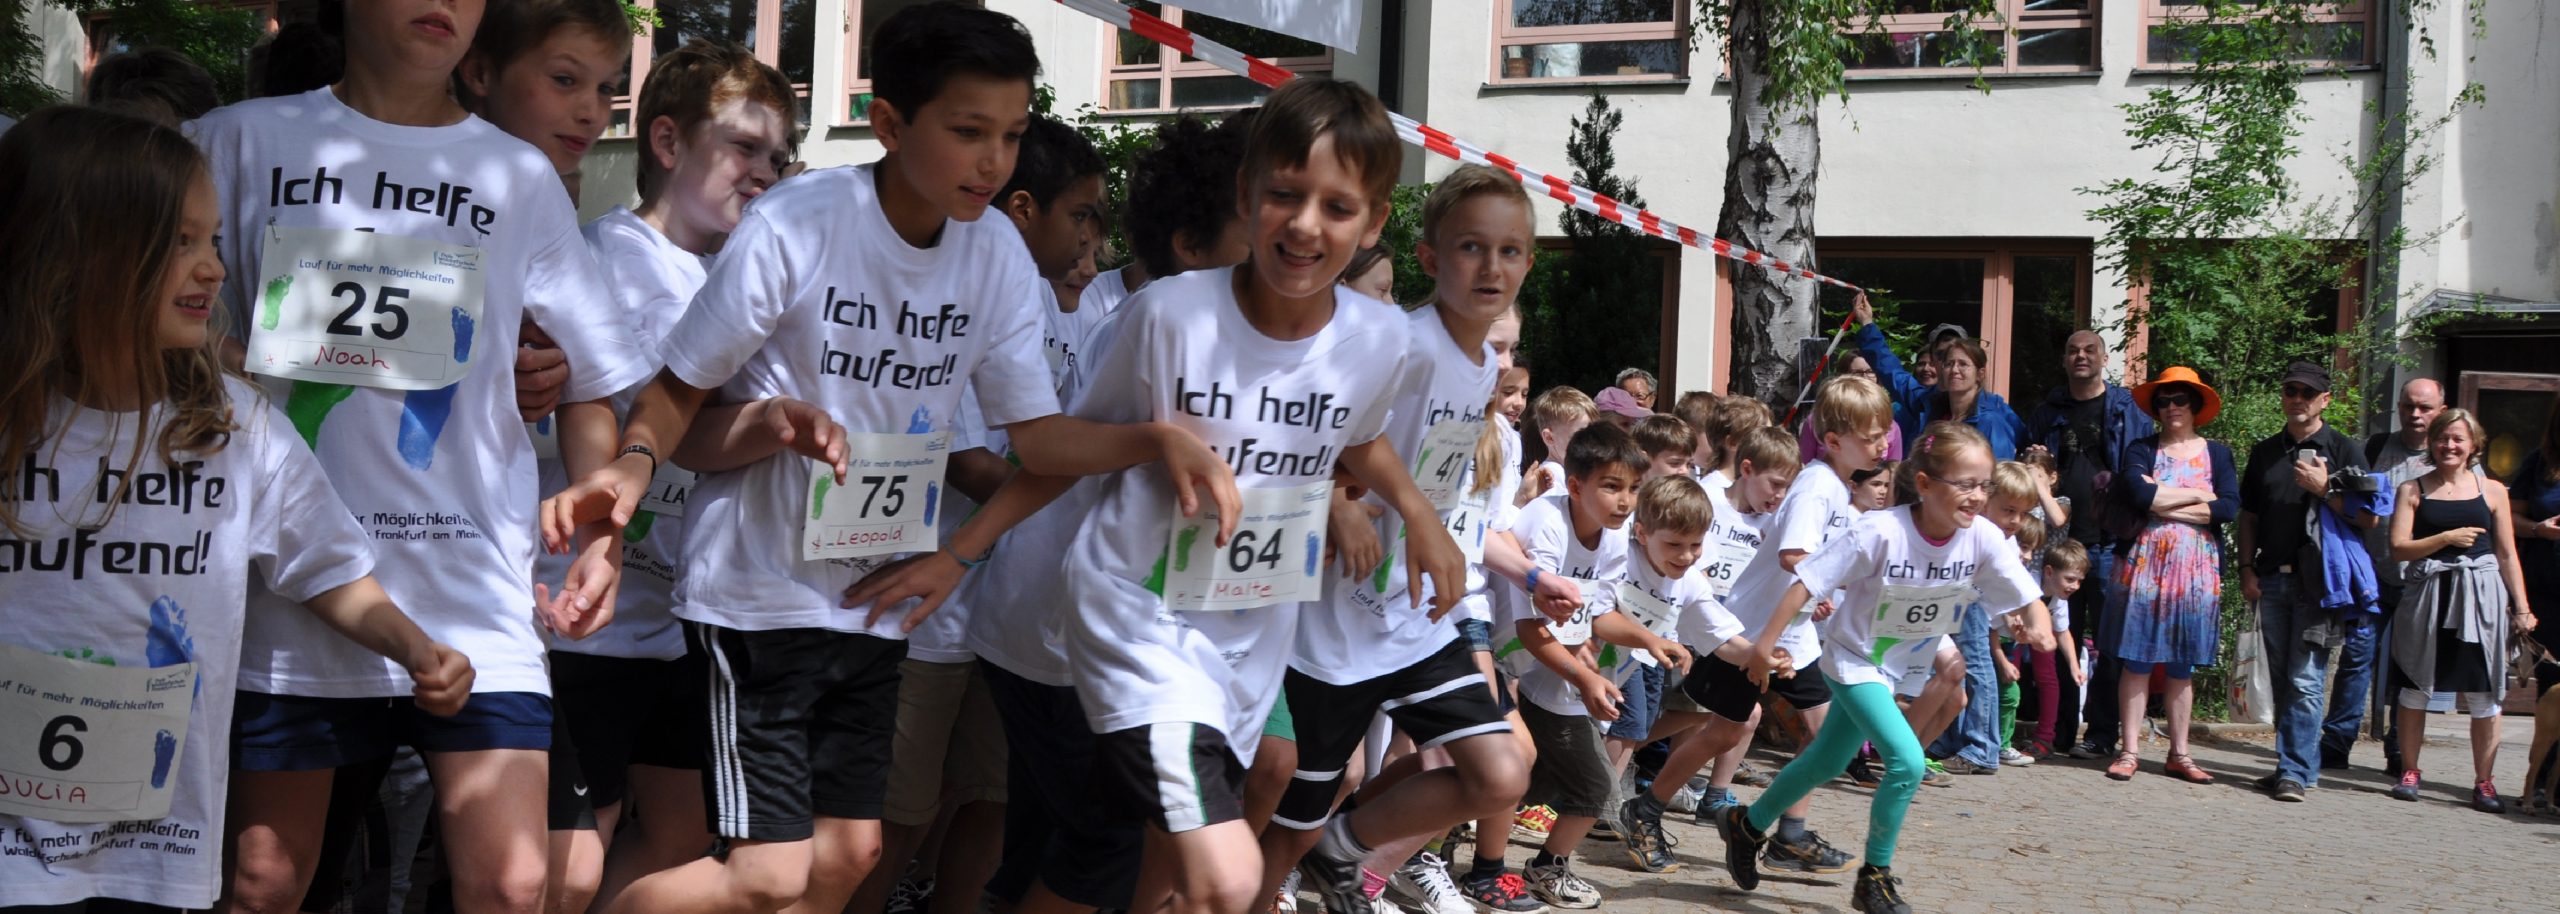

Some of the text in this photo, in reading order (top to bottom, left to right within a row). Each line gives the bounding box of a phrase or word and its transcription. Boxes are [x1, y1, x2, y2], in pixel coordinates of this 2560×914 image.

[270, 166, 496, 236] Ich helfe
[299, 258, 455, 285] Lauf für mehr Möglichkeiten
[325, 280, 410, 342] 25
[823, 285, 970, 344] Ich hefe
[314, 344, 391, 370] Noah
[1175, 376, 1352, 434] Ich helfe
[1210, 437, 1335, 477] fend!
[1435, 451, 1465, 483] 47
[0, 451, 226, 515] ch helfe
[859, 474, 908, 519] 75
[373, 512, 475, 528] Möglichkeite
[375, 529, 482, 541] Frankfurt am Main
[1228, 527, 1284, 574] 64
[1727, 525, 1761, 549] helfe
[0, 527, 213, 581] aufend!
[1706, 561, 1733, 581] 85
[1883, 559, 1975, 581] Ich helfe
[1906, 603, 1939, 624] 69
[17, 682, 37, 697] für
[42, 691, 75, 705] mehr
[79, 696, 164, 711] Möglichkeiten
[38, 714, 89, 772] 6
[41, 832, 83, 849] mehr
[140, 842, 158, 851] am
[163, 842, 197, 856] Main
